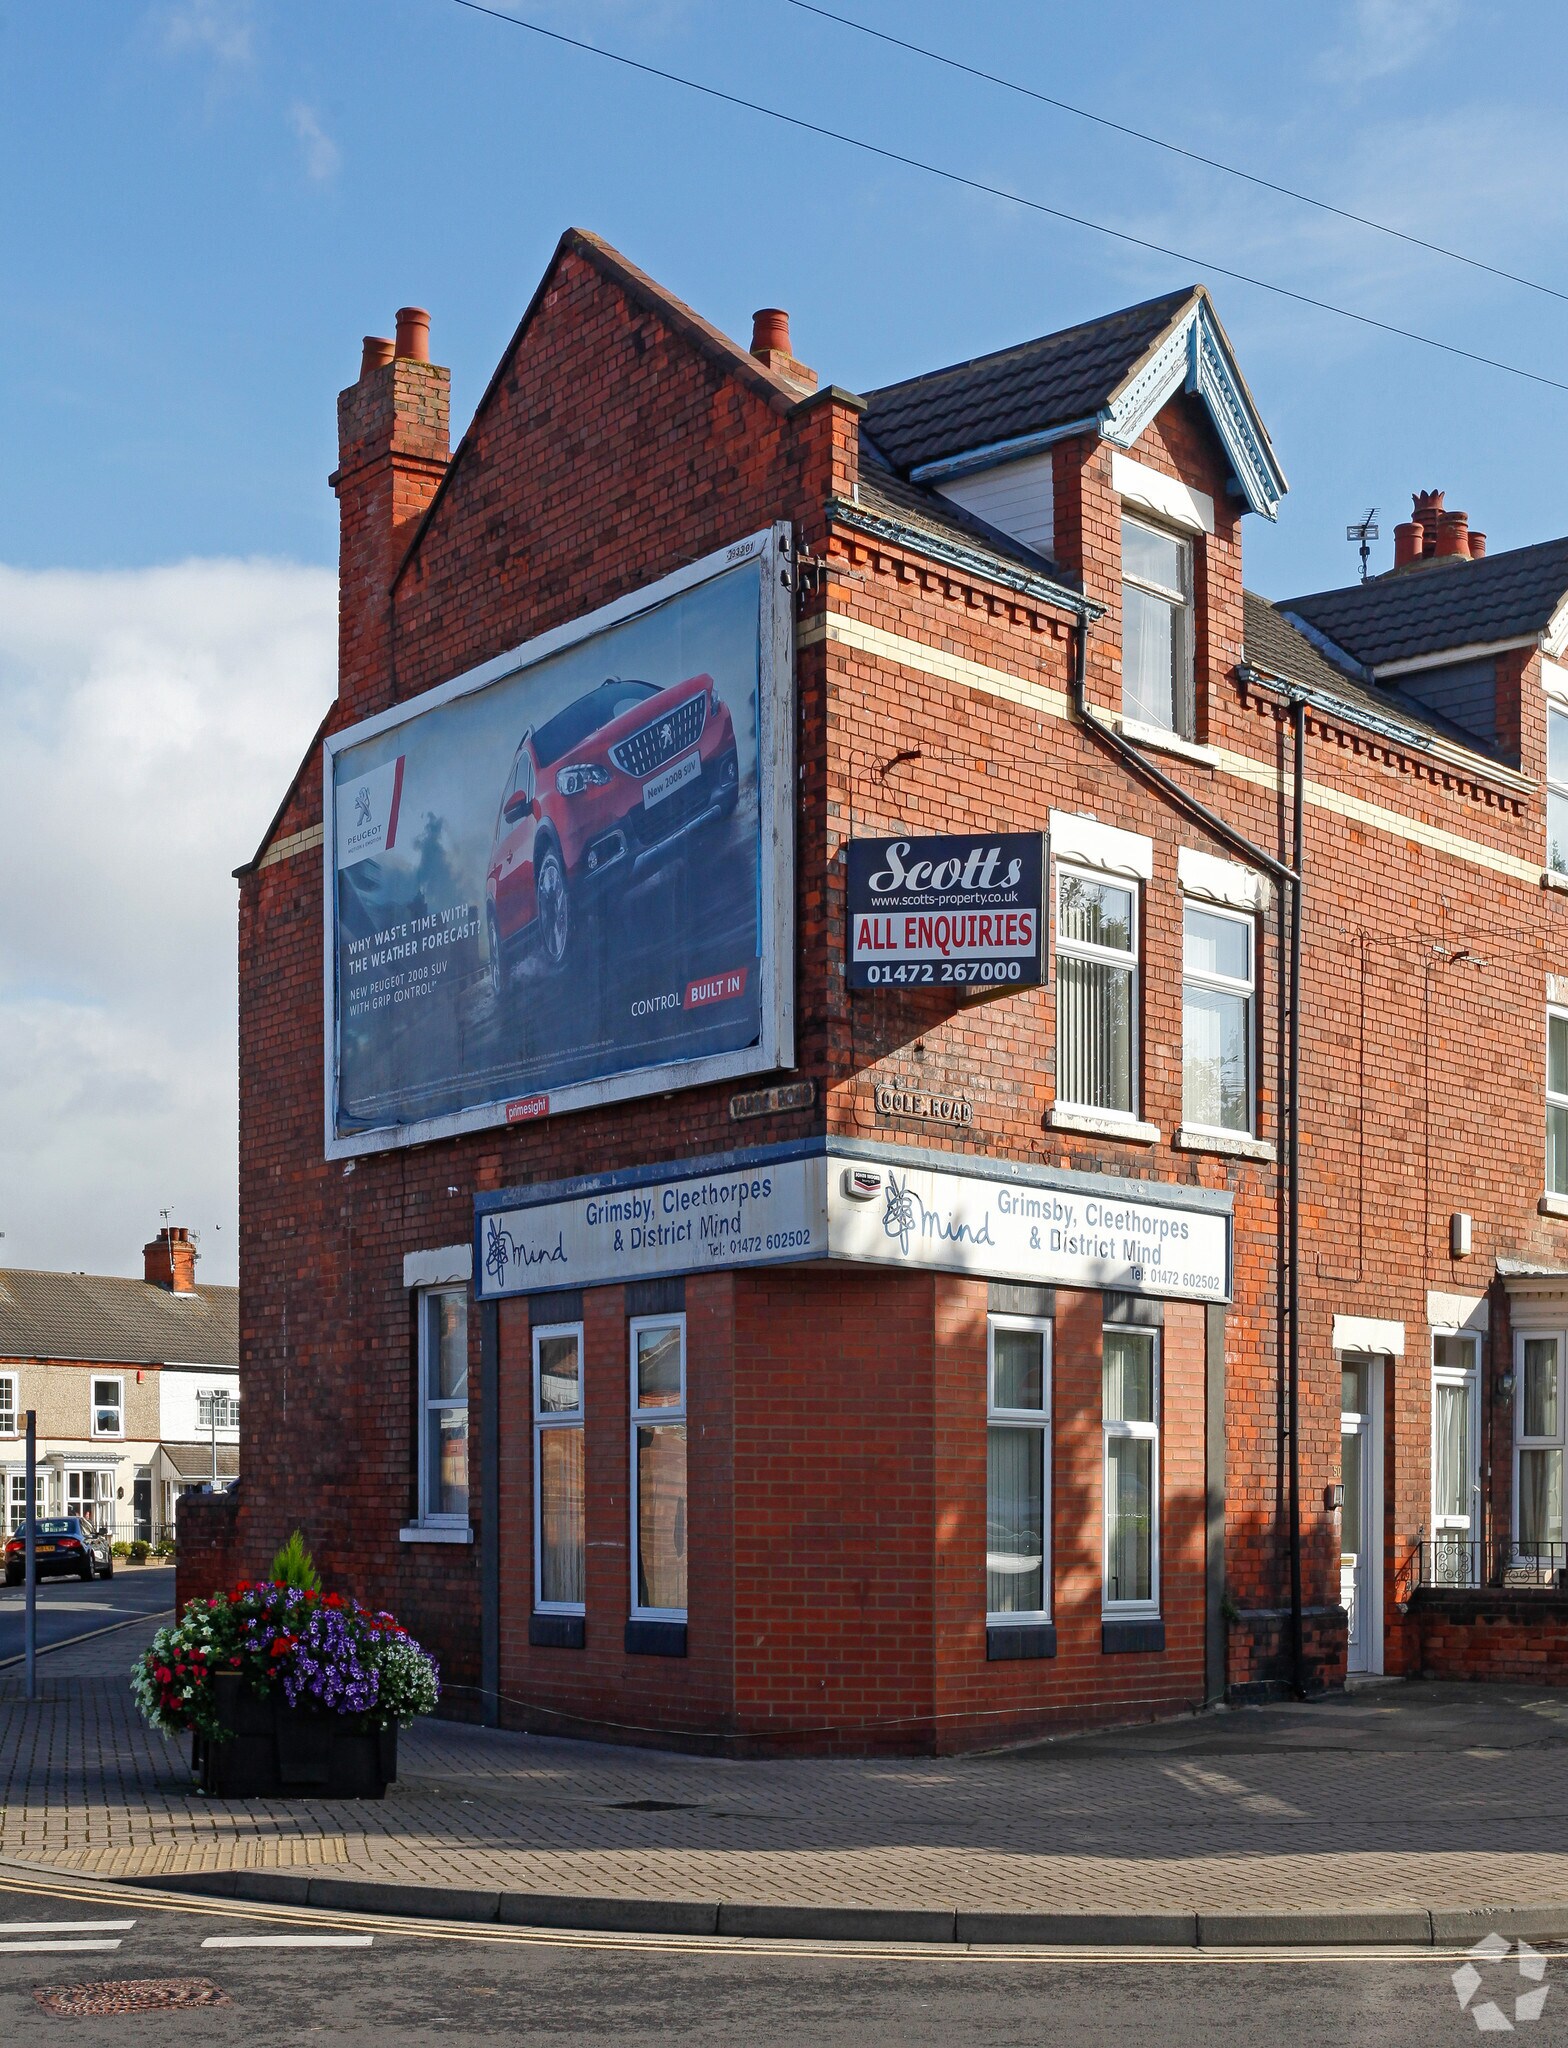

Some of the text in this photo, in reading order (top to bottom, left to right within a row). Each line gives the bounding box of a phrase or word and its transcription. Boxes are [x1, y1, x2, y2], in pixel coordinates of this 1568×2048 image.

[647, 784, 664, 799] New
[665, 769, 682, 788] 2008
[347, 824, 382, 846] PEUGEOT
[868, 842, 1022, 892] Scotts
[871, 891, 1018, 906] www.scotts-property.co.uk
[348, 903, 469, 955] WHY WASTE TIME WITH
[349, 920, 481, 975] THE WEATHER FORECAST?
[857, 913, 1032, 956] ALL ENQUIRIES
[350, 960, 448, 1001] NEW PEUGEOT 2008 SUV
[867, 962, 1021, 983] 01472 267000
[350, 1001, 370, 1016] WITH
[372, 994, 391, 1009] GRIP
[631, 976, 740, 1017] CONTROL BUILT IN
[508, 1098, 546, 1120] primesight
[930, 1098, 972, 1121] ROAD
[586, 1179, 772, 1226] Grimsby, Cleethorpes
[998, 1190, 1189, 1242] Grimsby, Cleethorpes
[613, 1211, 741, 1252] & District Mind
[708, 1229, 811, 1256] Tel: 01472 602502
[1029, 1225, 1161, 1265] & District Mind
[1130, 1265, 1220, 1290] Tel: 01472 602502
